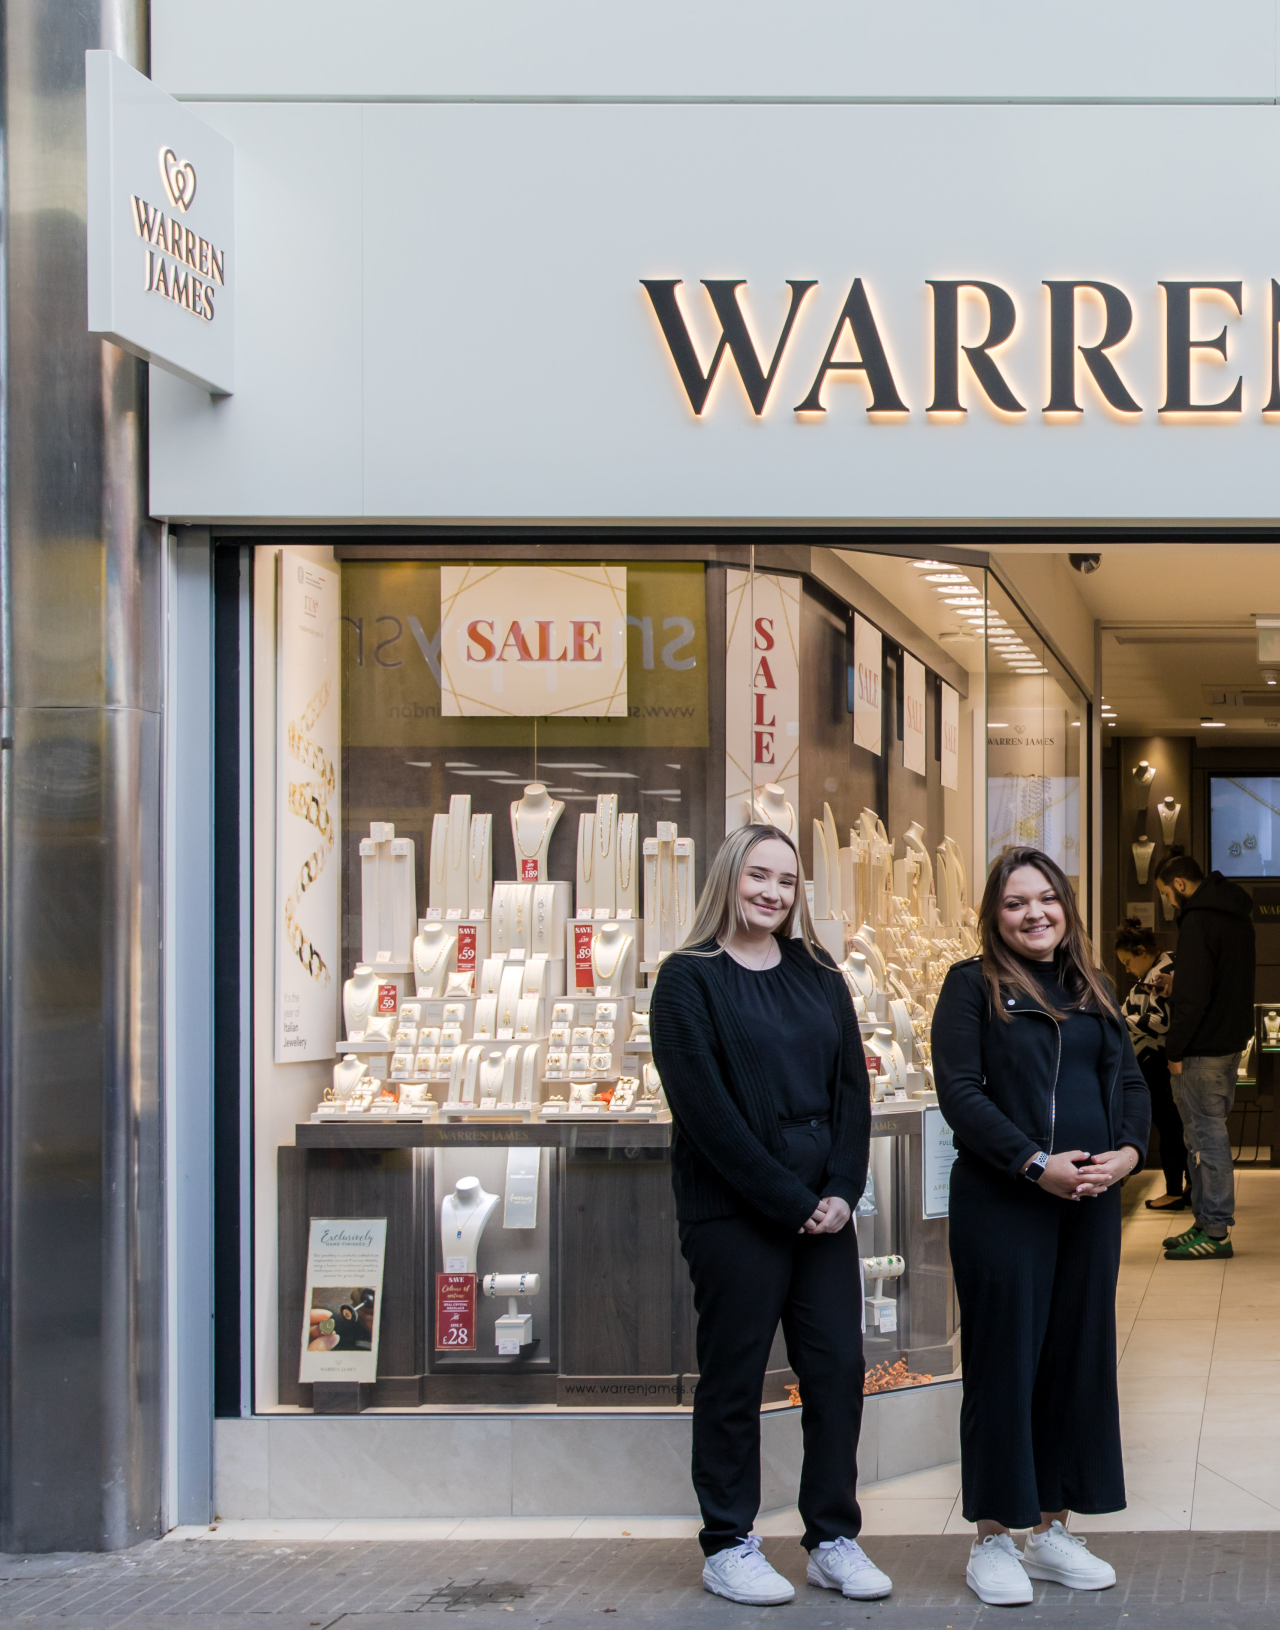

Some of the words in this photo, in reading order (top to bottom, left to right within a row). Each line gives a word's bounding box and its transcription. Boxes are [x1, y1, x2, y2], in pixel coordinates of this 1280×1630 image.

[130, 194, 225, 286] WARREN
[144, 250, 215, 321] JAMES
[466, 620, 603, 662] SALE
[753, 617, 777, 765] SALE
[858, 663, 879, 709] SALE
[907, 695, 924, 735] SALE
[944, 720, 957, 755] SALE
[1026, 738, 1055, 747] JAMES
[283, 1035, 307, 1049] Jewellery
[439, 1130, 488, 1141] WARREN
[491, 1130, 529, 1141] JAMES
[870, 1121, 898, 1132] AMES
[320, 1229, 374, 1247] Exclusively
[442, 1327, 468, 1345] £28
